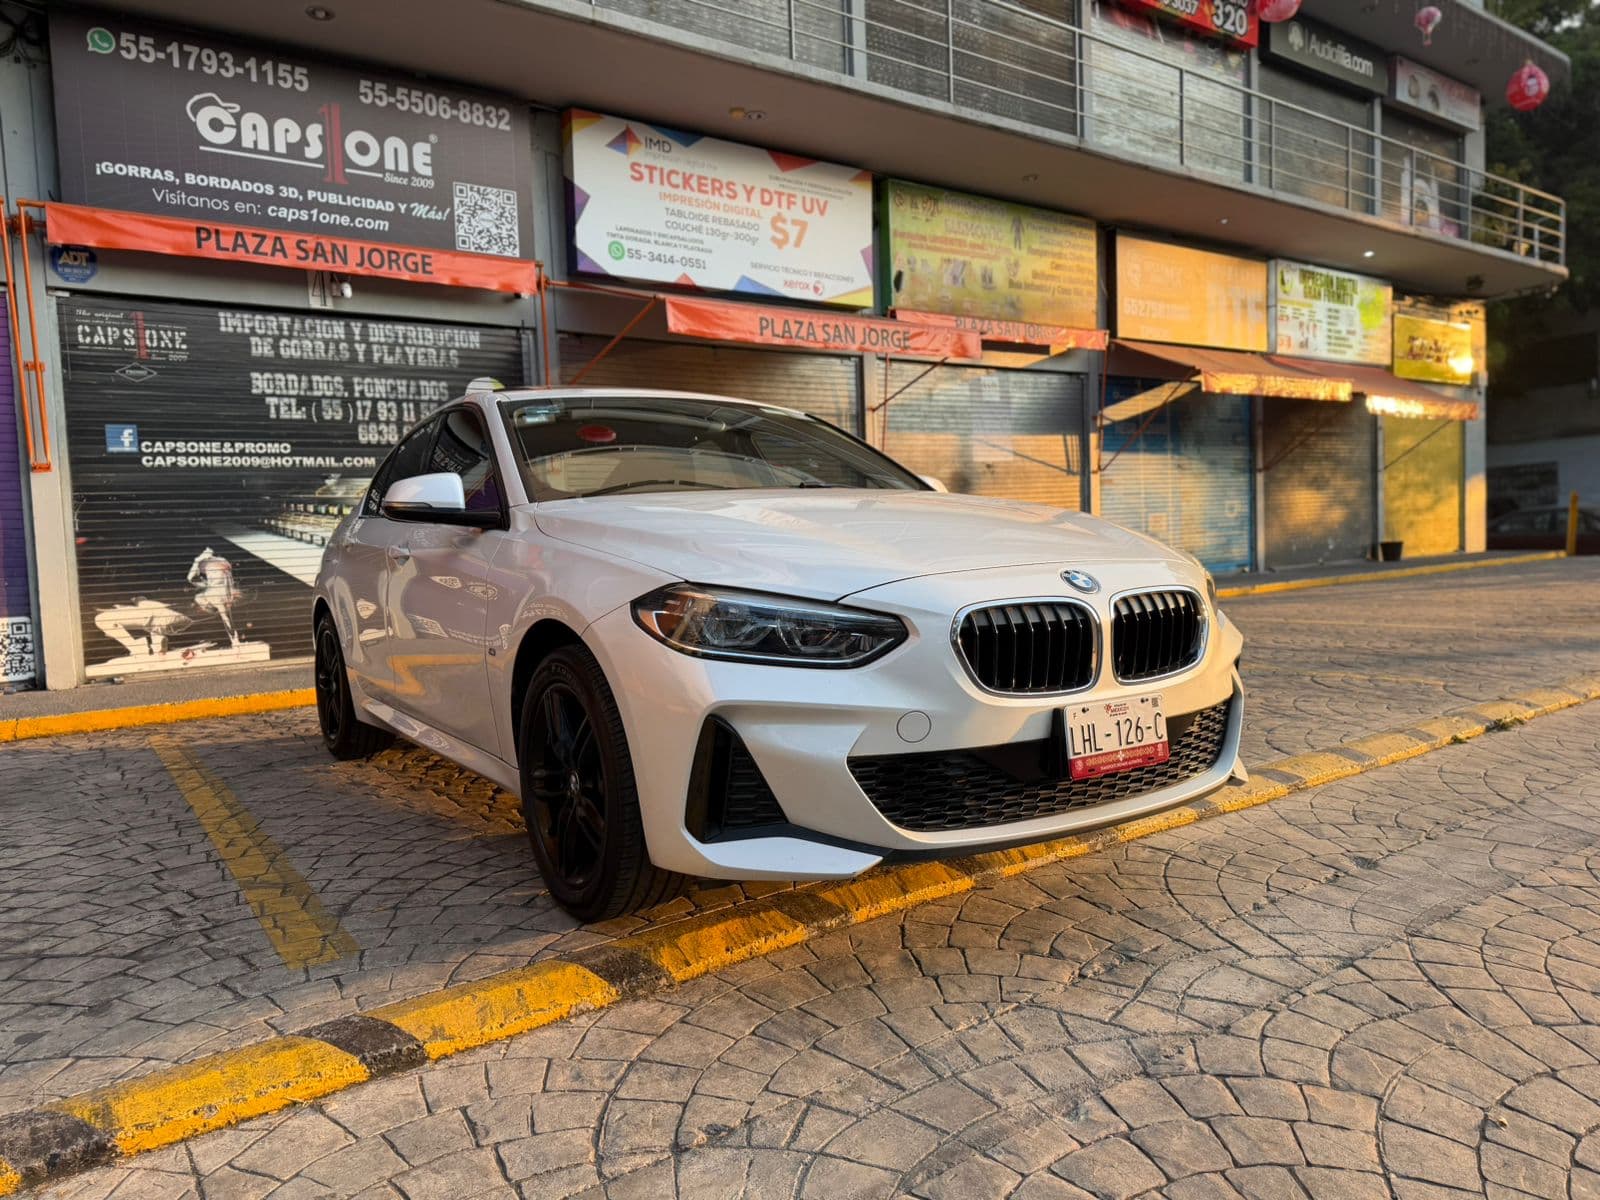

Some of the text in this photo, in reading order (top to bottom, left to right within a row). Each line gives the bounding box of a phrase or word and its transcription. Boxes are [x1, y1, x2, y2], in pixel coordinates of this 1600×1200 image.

[1212, 0, 1248, 35] 320
[120, 32, 309, 92] 55-1793-1155
[359, 80, 511, 131] 55-5506-8832
[644, 136, 672, 153] IMD
[96, 161, 451, 221] ¡GORRAS, BORDADOS 3D, PUBLICIDAD Y Más!
[384, 173, 435, 189] Since 2009
[629, 161, 738, 199] STICKERS
[742, 183, 756, 203] Y
[760, 188, 797, 211] DTF
[802, 195, 828, 217] UV
[152, 187, 390, 231] Visítanos en: caps1one.com
[665, 207, 760, 231] TABLOIDE REBASADO
[722, 202, 763, 219] DIGITAL
[770, 212, 809, 250] $7
[59, 251, 89, 266] ADT
[195, 226, 433, 275] PLAZA SAN JORGE
[218, 311, 481, 350] IMPORTACION Y DISTRIBUCION
[759, 316, 911, 350] PLAZA SAN JORGE
[250, 337, 275, 358] DE
[279, 338, 350, 361] GORRAS
[354, 343, 367, 363] Y
[265, 397, 307, 420] TEL:
[356, 401, 371, 421] 17
[377, 402, 398, 422] 93
[402, 402, 416, 422] 11
[141, 439, 291, 454] CAPSONE&PROMO
[141, 455, 376, 468] CAPSONE2009@HOTMAIL.COM
[1070, 712, 1164, 755] LHL-126-C
